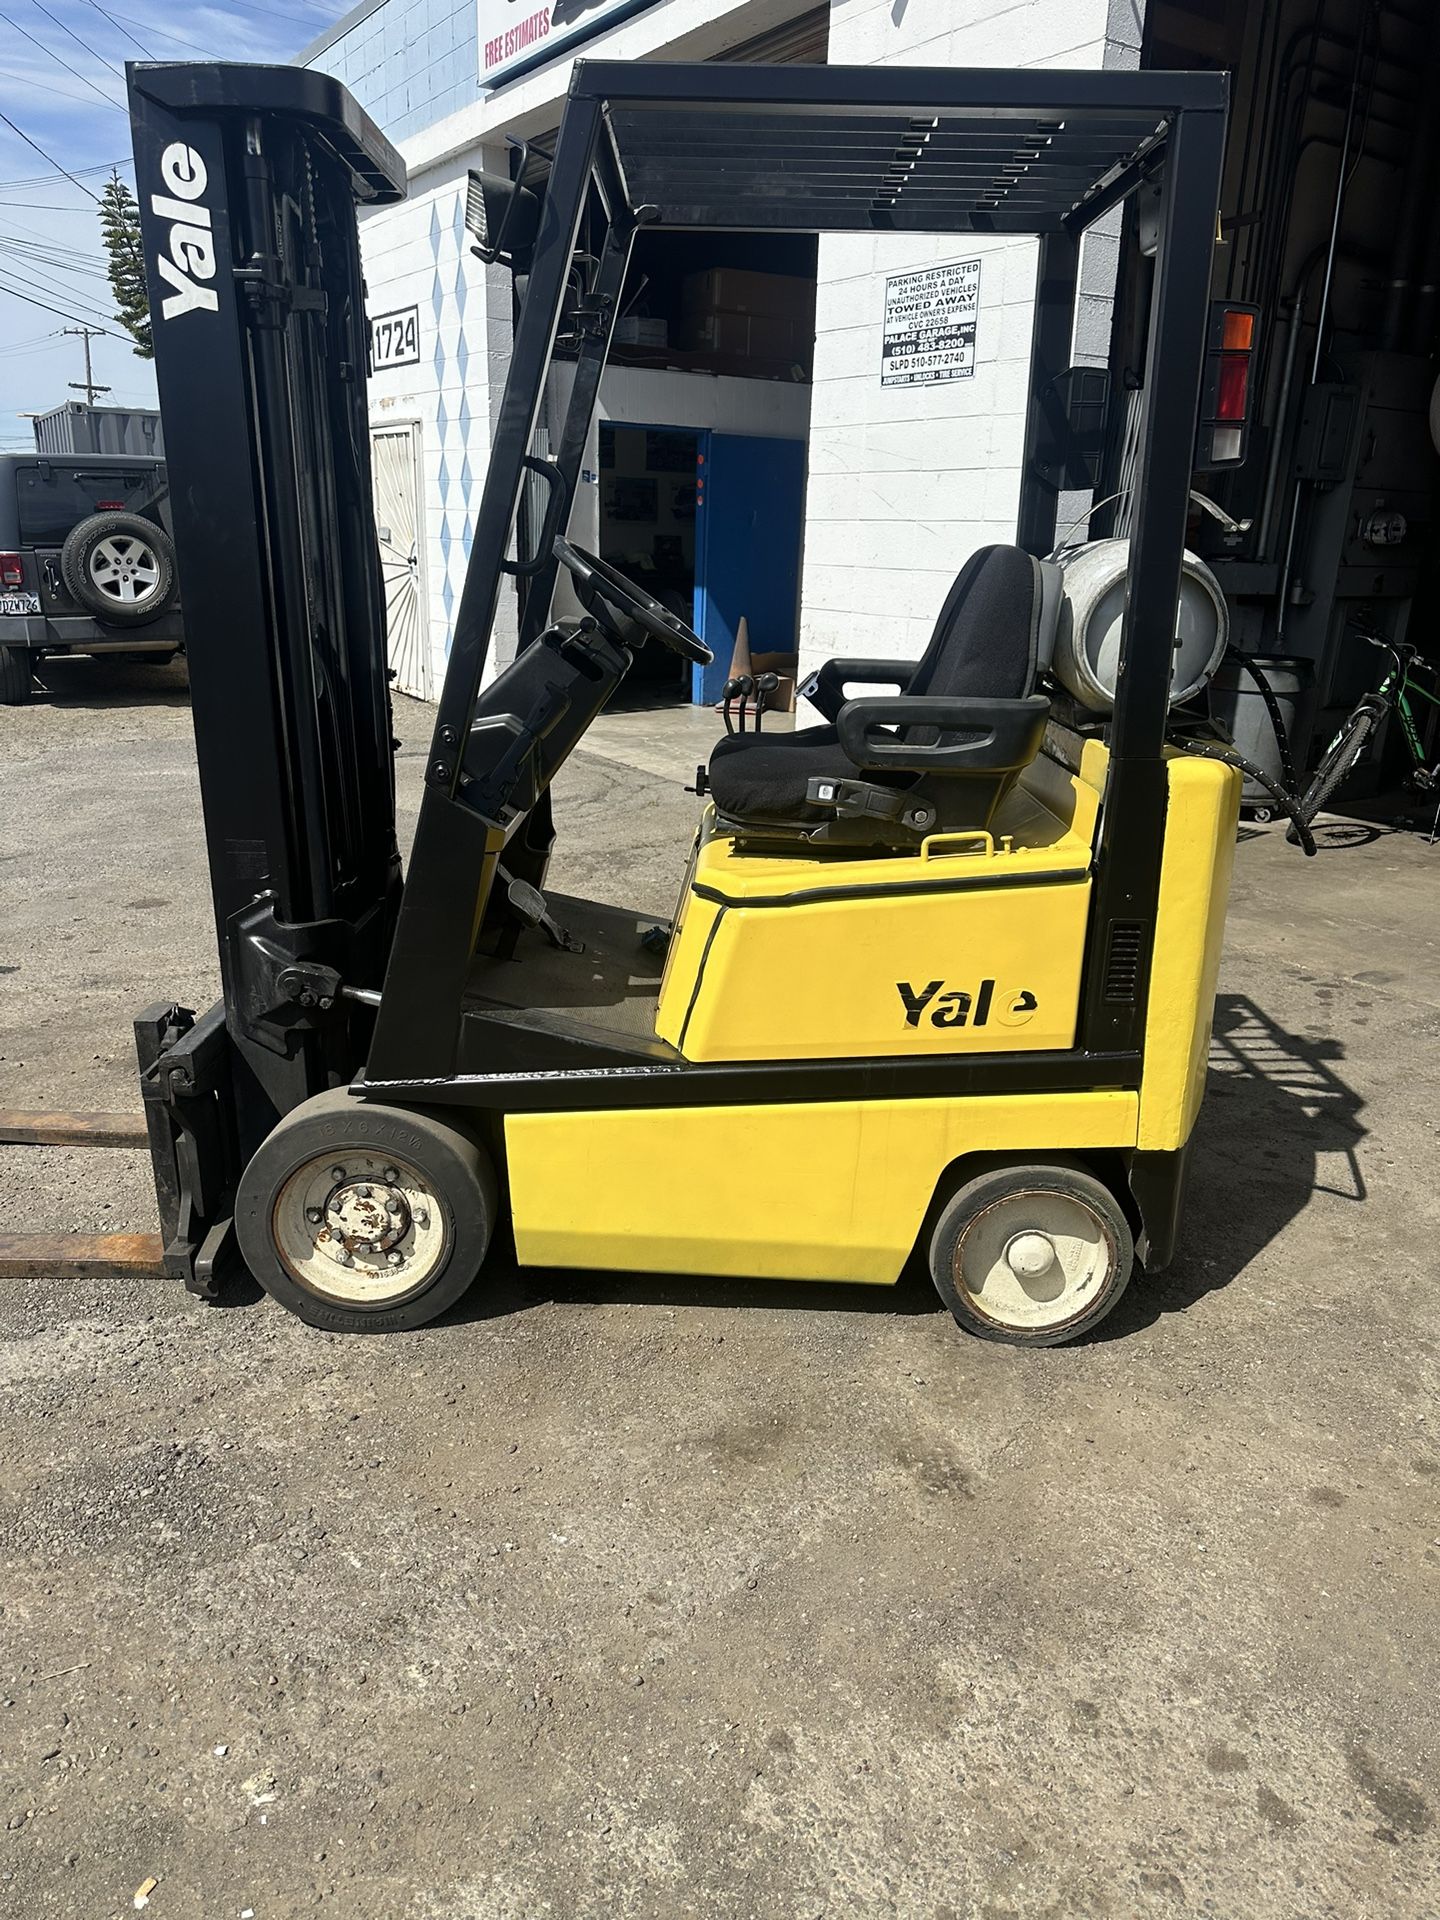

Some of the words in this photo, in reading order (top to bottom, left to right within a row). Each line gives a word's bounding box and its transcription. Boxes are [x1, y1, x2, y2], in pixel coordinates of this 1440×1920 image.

[484, 34, 504, 70] FREE
[504, 7, 550, 58] ESTIMATES
[151, 142, 219, 320] Yale
[888, 275, 923, 288] PARKING
[925, 264, 979, 280] RESTRICTED
[898, 287, 908, 296] 24
[910, 281, 939, 293] HOURS
[940, 279, 946, 287] A
[948, 275, 965, 286] DAY
[887, 290, 940, 307] UNAUTHORIZED
[941, 282, 977, 297] VEHICLES
[887, 301, 931, 315] TOWED
[935, 292, 976, 308] AWAY
[886, 316, 893, 324] AT
[895, 311, 919, 323] VEHICLE
[920, 307, 946, 319] OWNER'S
[947, 302, 976, 315] EXPENSE
[908, 320, 924, 330] CVC
[925, 316, 949, 327] 22658
[375, 316, 416, 360] 1724
[884, 331, 918, 345] PALACE
[891, 344, 916, 356] (510)
[917, 337, 965, 352] 483-8200
[889, 358, 910, 371] SLPD
[911, 351, 965, 369] 510-577-2740
[0, 599, 38, 612] DZW726
[896, 979, 1038, 1030] Yale
